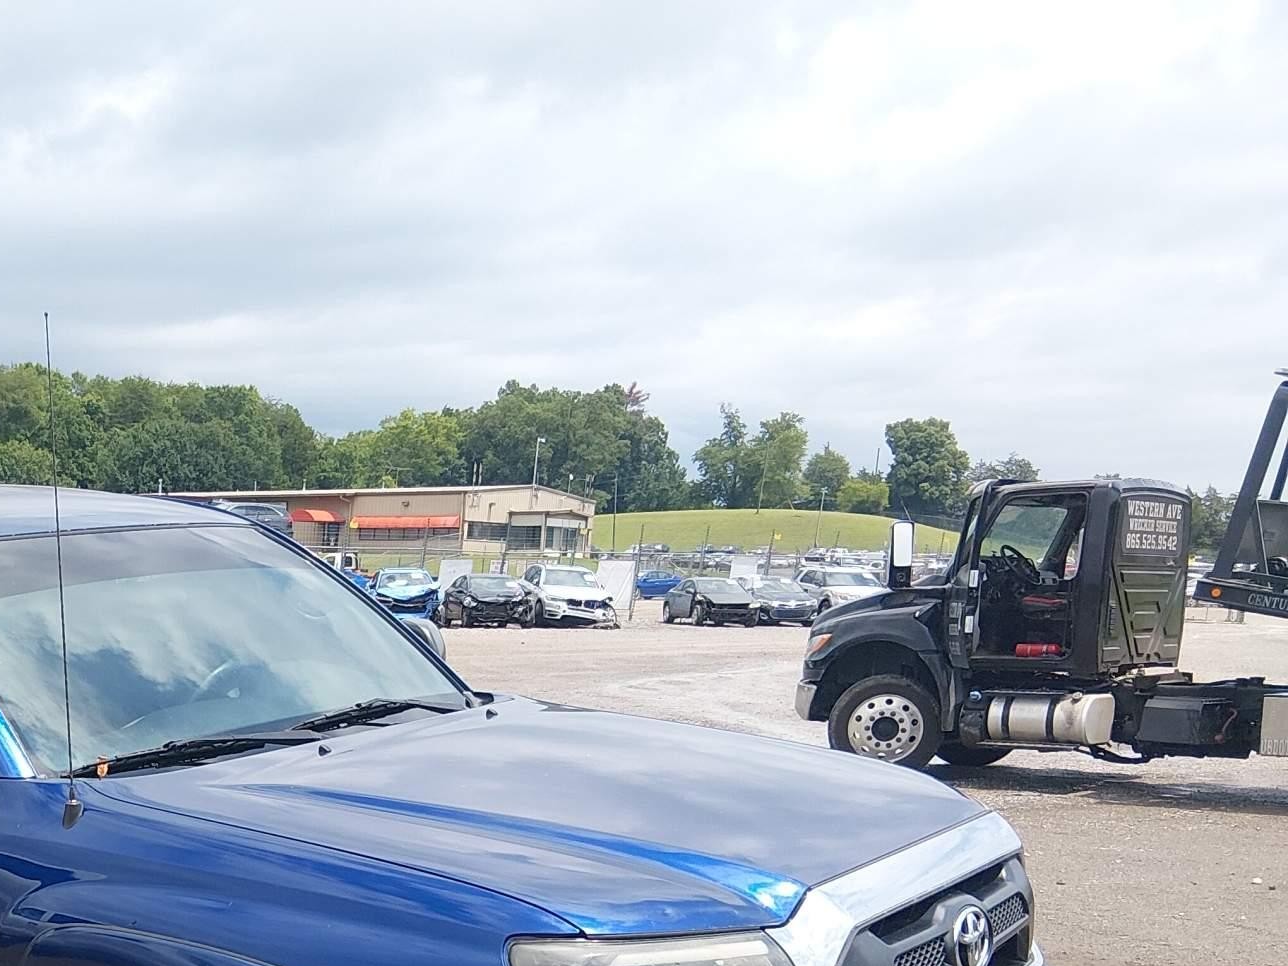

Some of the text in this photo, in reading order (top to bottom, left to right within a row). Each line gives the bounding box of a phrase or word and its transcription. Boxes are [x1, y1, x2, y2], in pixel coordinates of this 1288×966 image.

[1127, 500, 1183, 519] WESTERN AVE
[1125, 533, 1178, 551] 865.525.9542
[1247, 593, 1288, 611] CENTU
